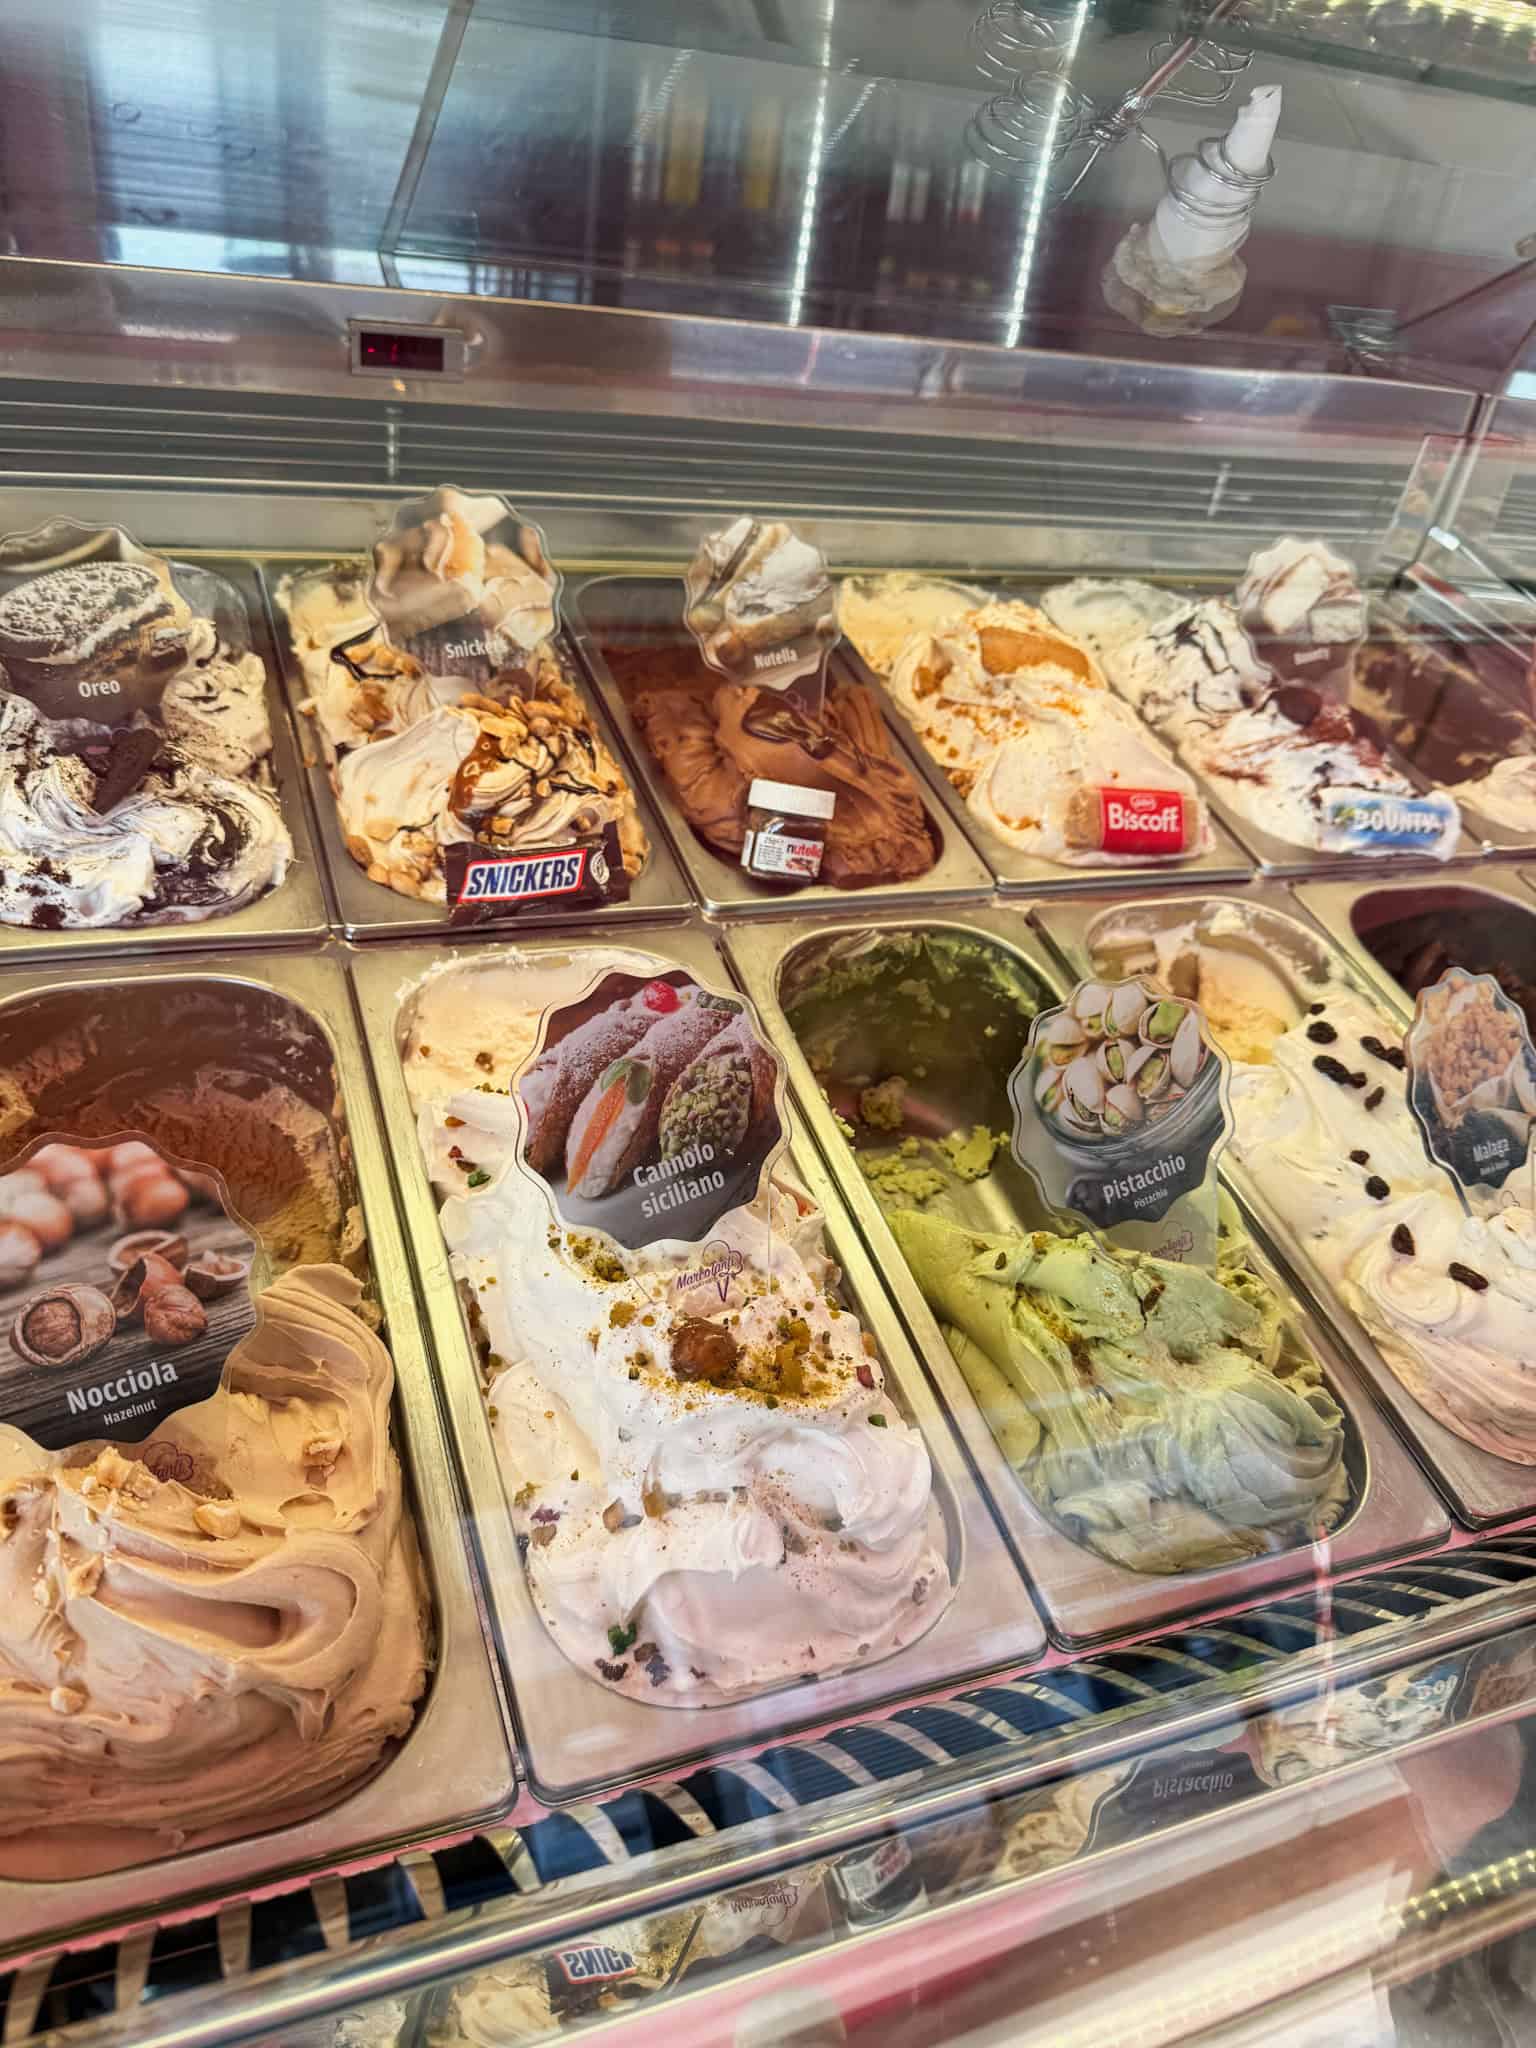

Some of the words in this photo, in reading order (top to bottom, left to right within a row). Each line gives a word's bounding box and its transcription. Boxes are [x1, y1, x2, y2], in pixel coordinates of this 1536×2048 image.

[445, 639, 508, 660] Snicke
[754, 647, 798, 669] Nutella
[78, 679, 121, 698] Oreo
[1107, 801, 1179, 832] Biscoff
[1353, 803, 1437, 834] BOUNTY
[467, 857, 580, 896] SNICKERS
[633, 1143, 715, 1188] Cannolo
[1102, 1154, 1186, 1204] Pistacchio
[641, 1171, 725, 1218] siciliano
[1134, 1188, 1169, 1209] Pistachio
[66, 1362, 178, 1414] Nocciola
[103, 1399, 157, 1425] Hazelnut
